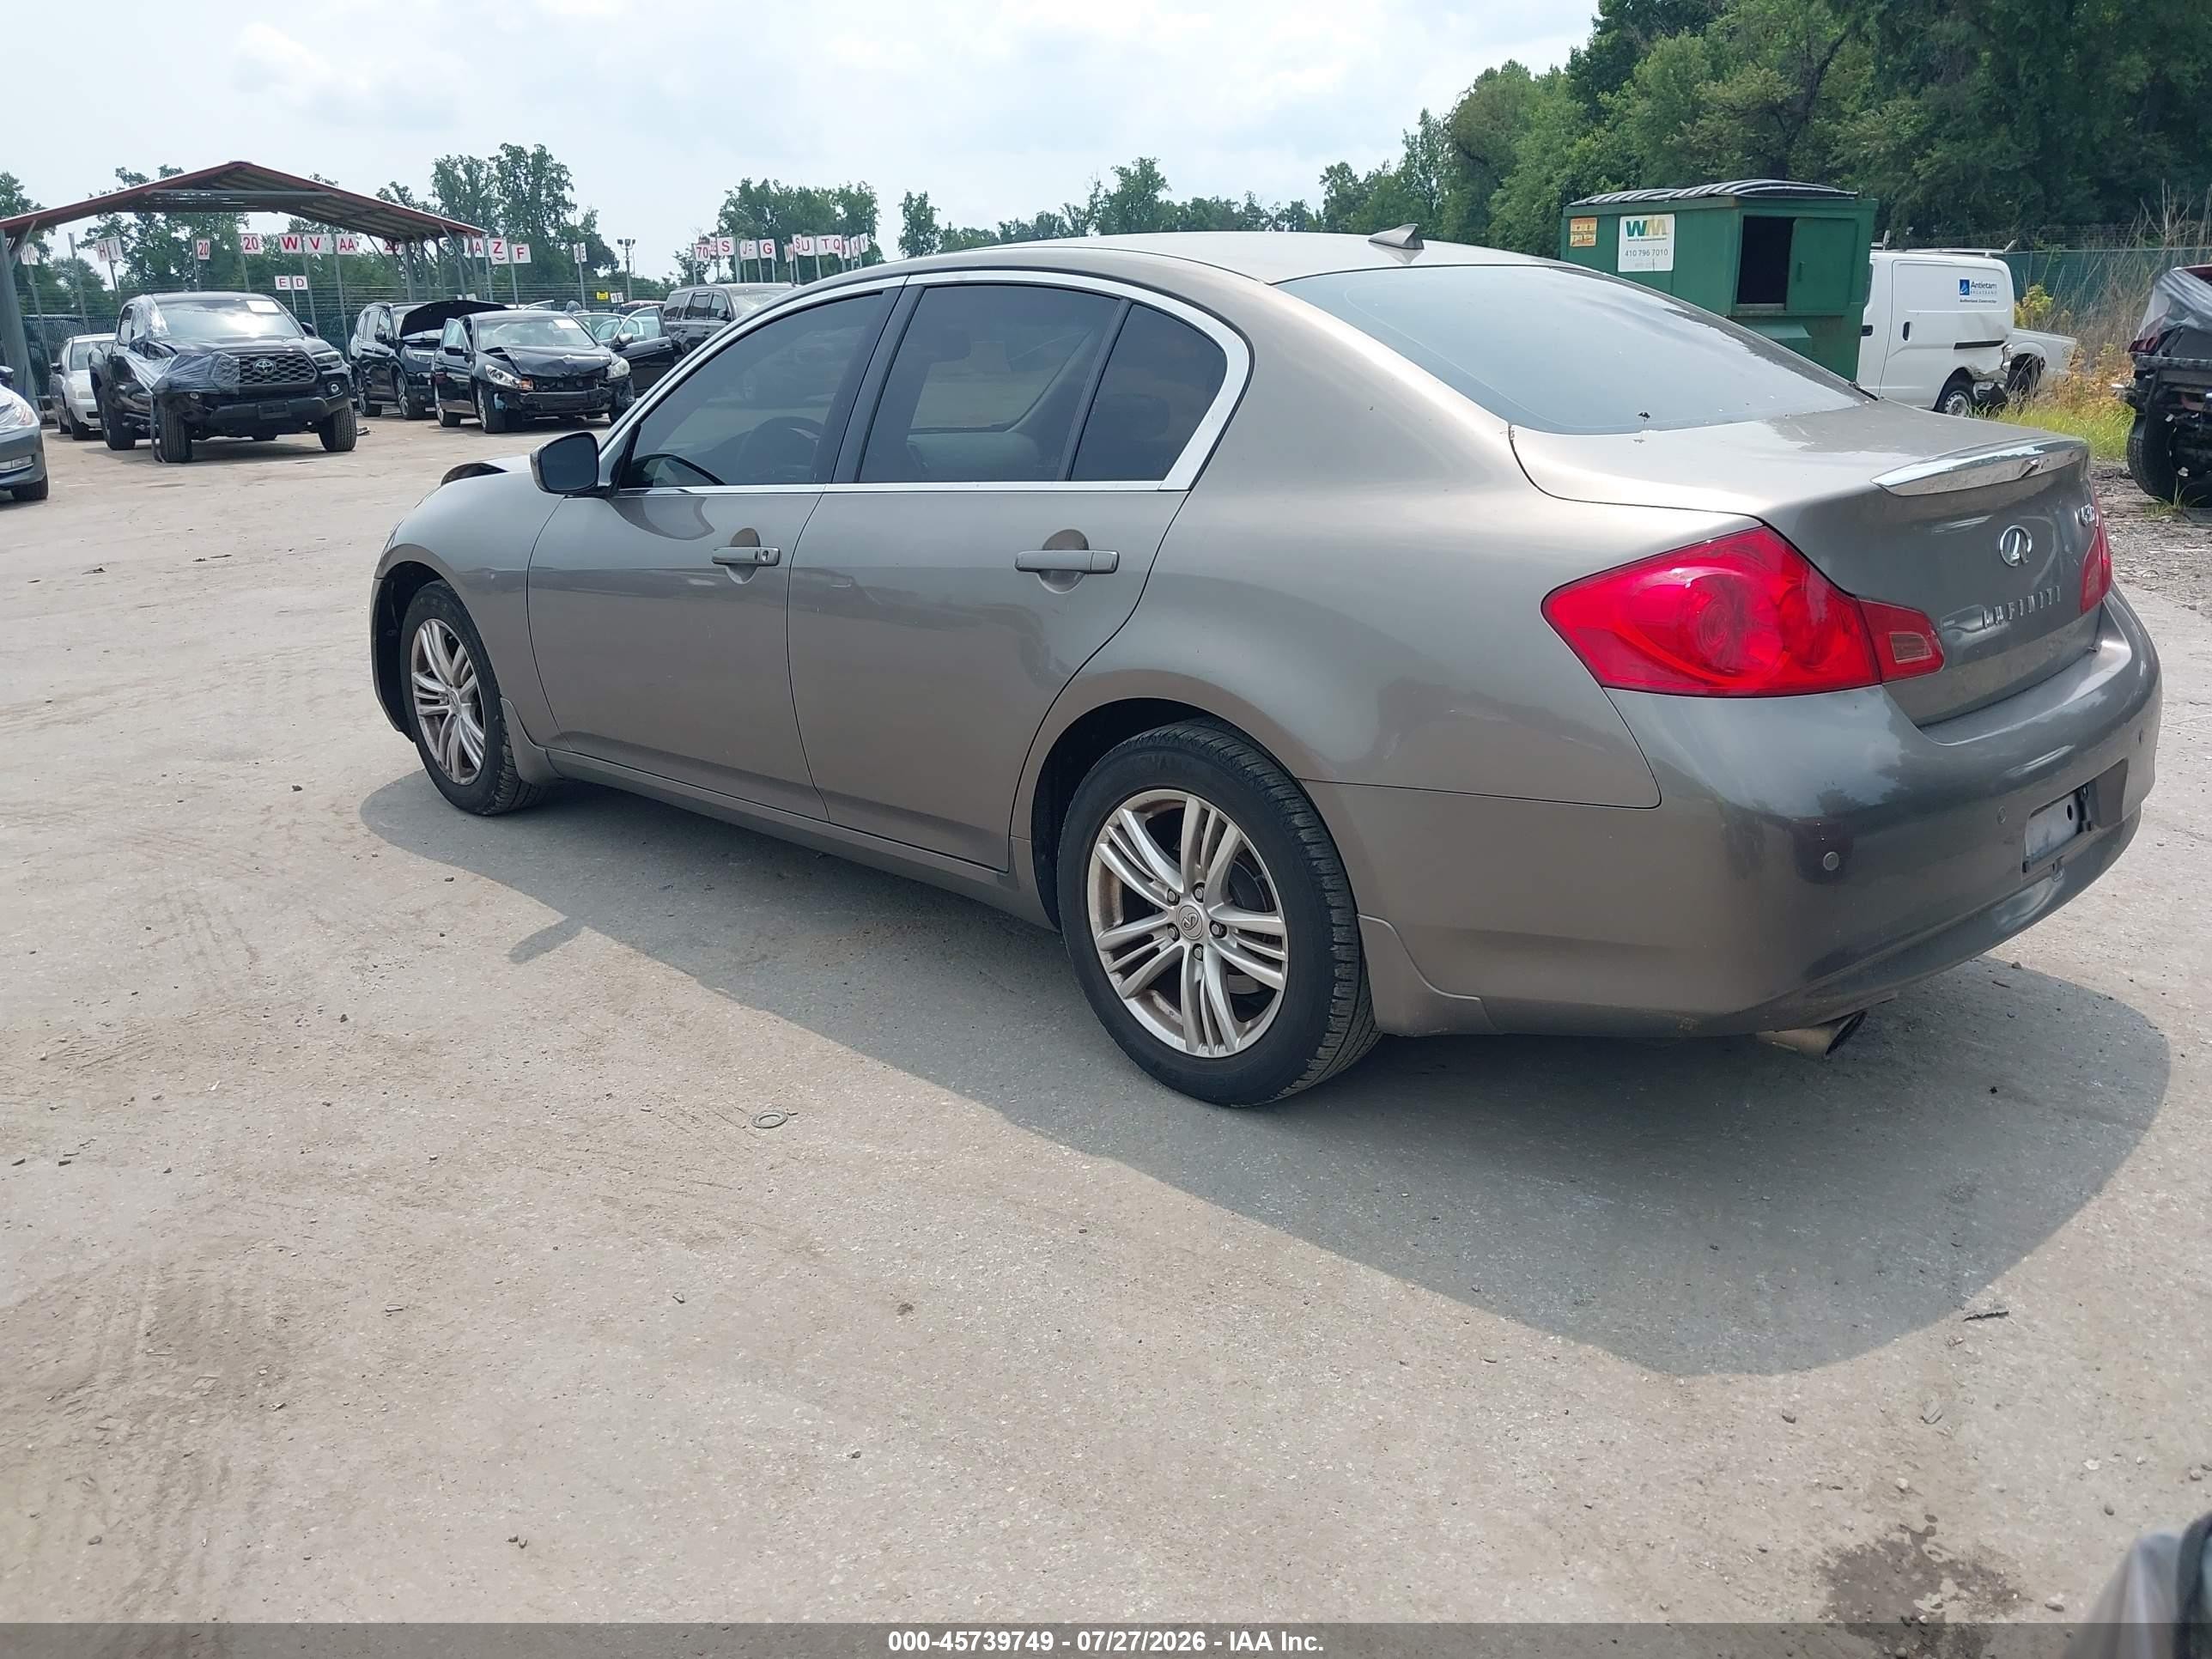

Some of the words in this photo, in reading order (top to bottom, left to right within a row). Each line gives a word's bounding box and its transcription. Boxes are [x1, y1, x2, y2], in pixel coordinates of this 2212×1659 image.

[1626, 220, 1667, 237] WM
[198, 242, 209, 255] 20
[243, 236, 258, 251] 20
[281, 236, 299, 250] W
[309, 236, 320, 250] V
[339, 238, 356, 252] AA
[721, 240, 730, 252] S
[763, 243, 772, 254] G
[802, 240, 810, 252] U
[821, 239, 830, 250] T
[833, 239, 841, 250] Q
[98, 246, 106, 258] H
[516, 247, 525, 259] F
[696, 246, 708, 258] 70
[279, 277, 286, 288] E
[296, 277, 304, 288] D
[1971, 281, 1997, 289] Antietam
[1983, 586, 2061, 628] INFINITI
